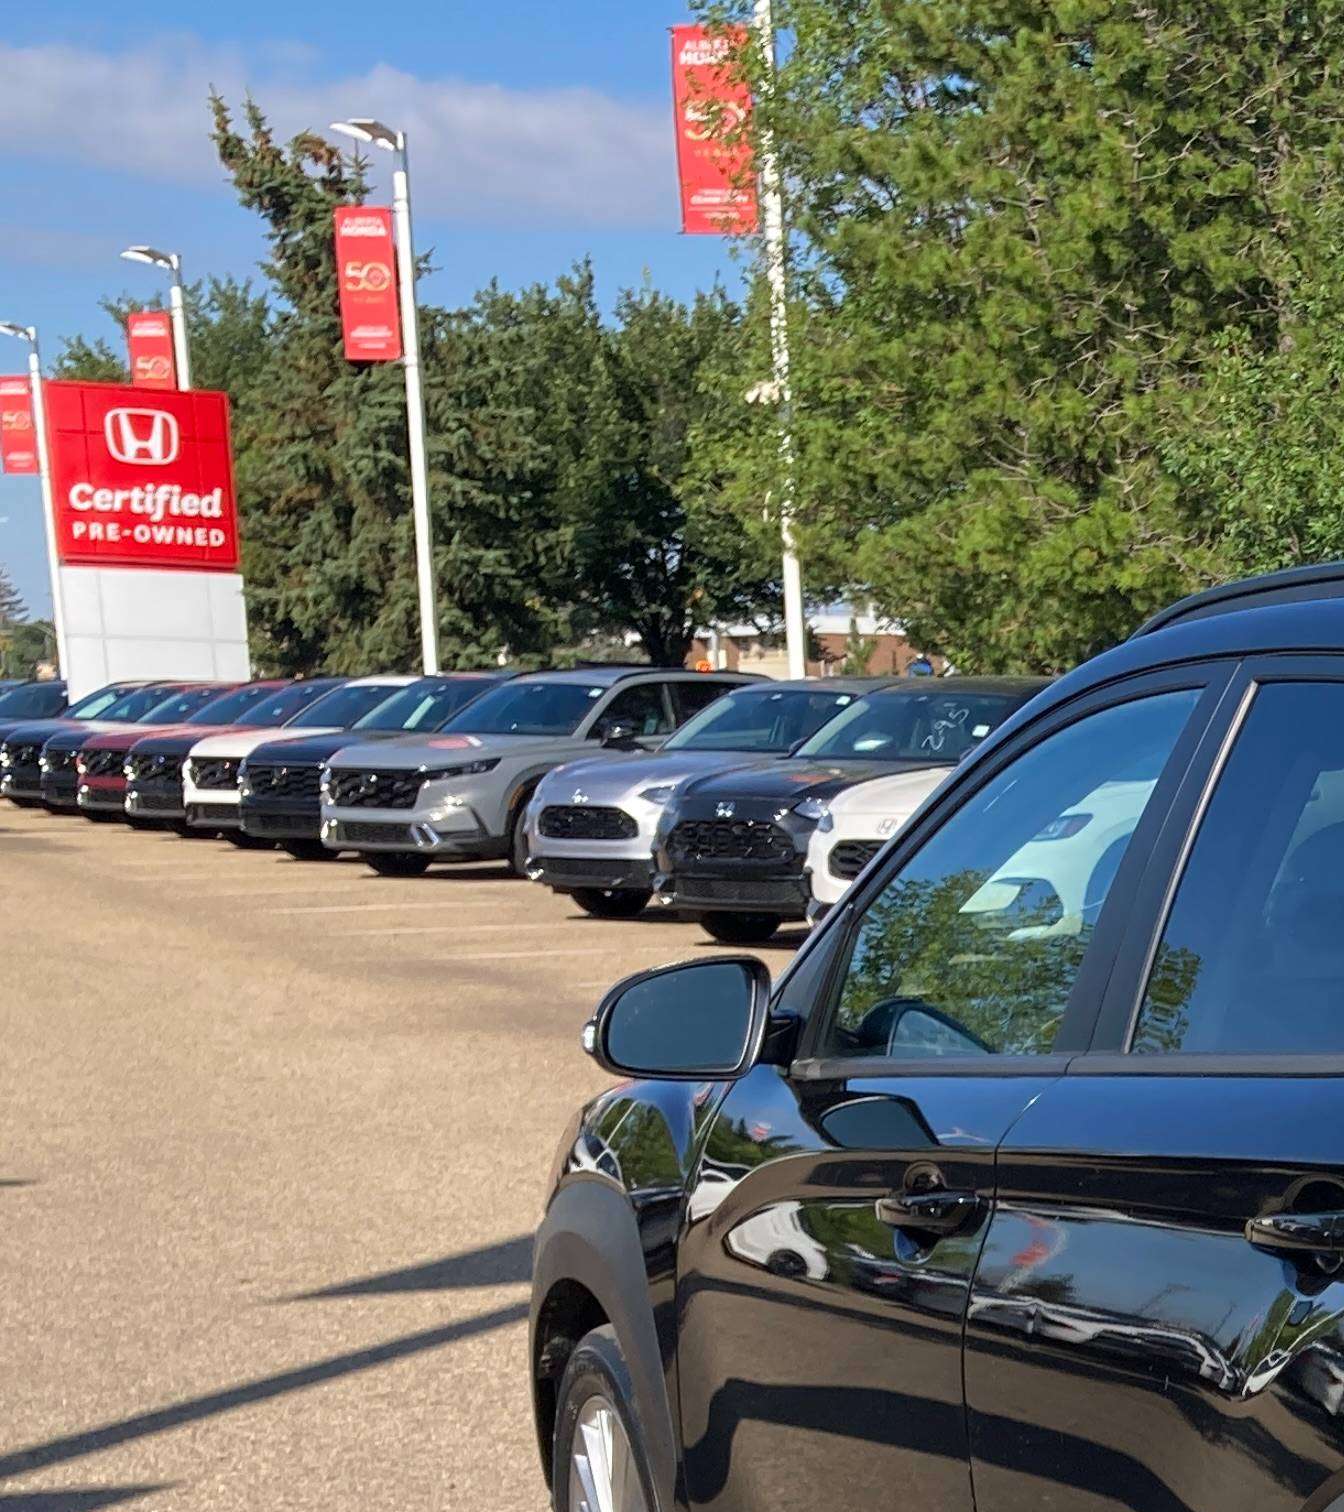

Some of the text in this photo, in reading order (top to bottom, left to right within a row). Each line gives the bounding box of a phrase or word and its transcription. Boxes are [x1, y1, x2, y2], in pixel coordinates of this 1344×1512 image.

[345, 261, 392, 292] 50
[69, 482, 223, 522] Certified
[72, 521, 226, 547] PRE-OWNED
